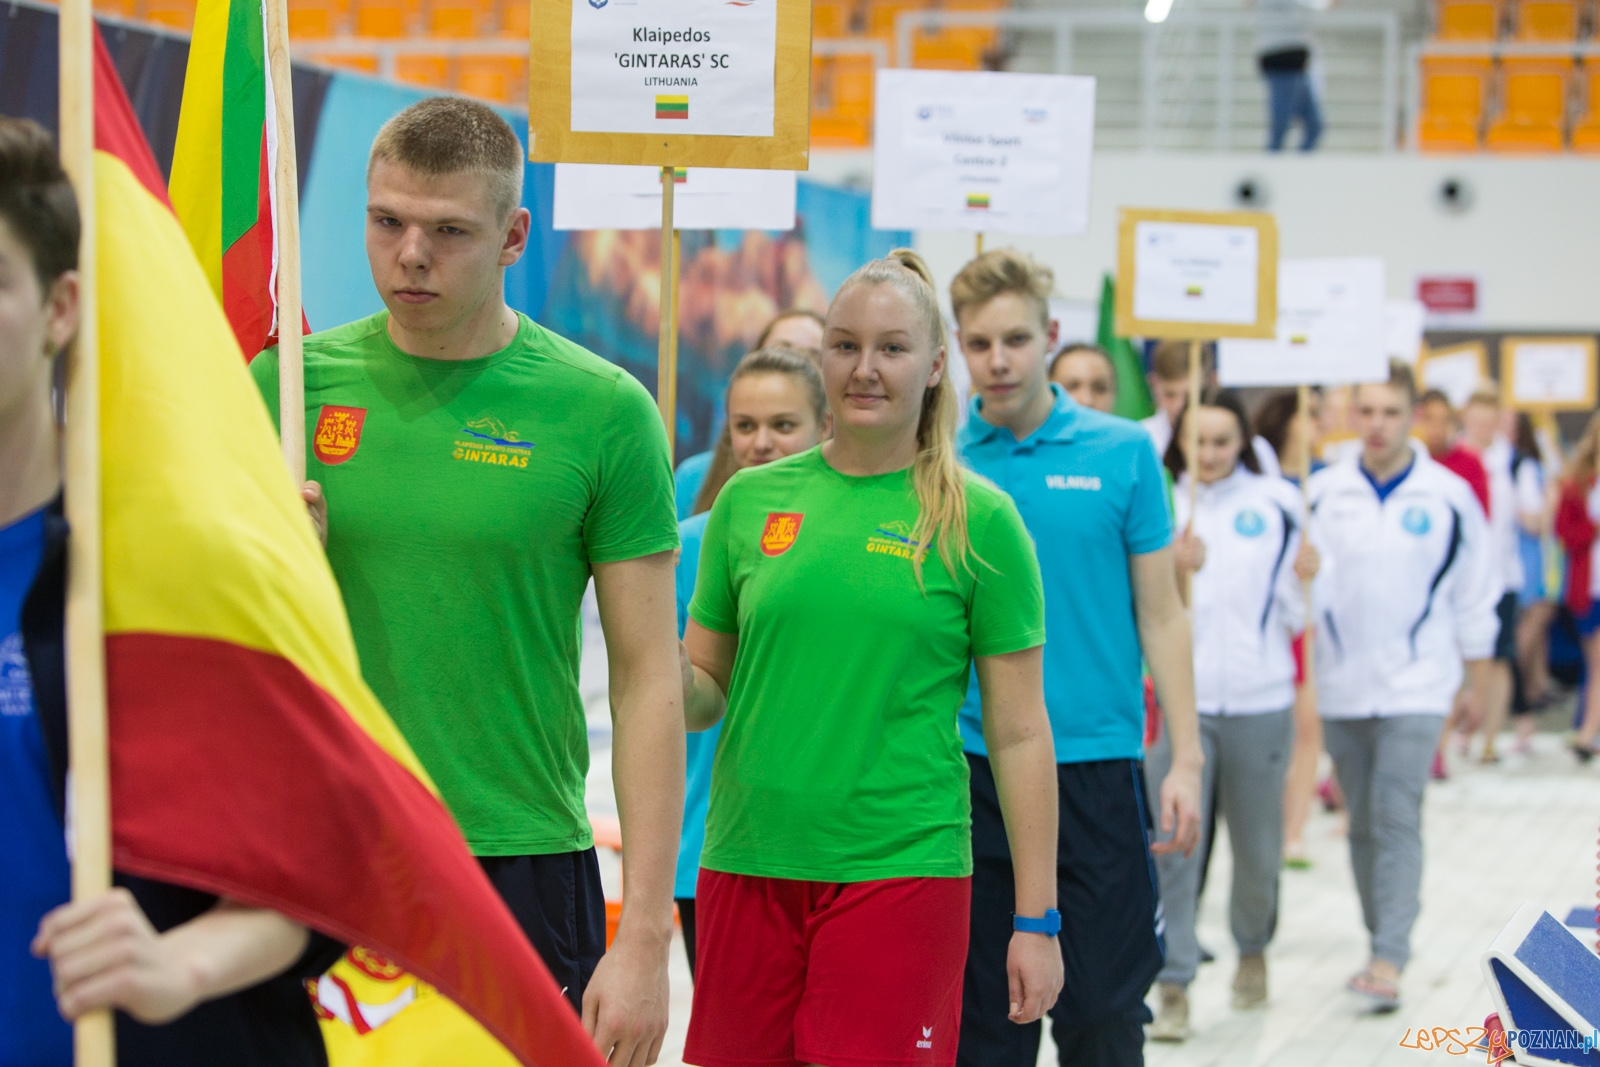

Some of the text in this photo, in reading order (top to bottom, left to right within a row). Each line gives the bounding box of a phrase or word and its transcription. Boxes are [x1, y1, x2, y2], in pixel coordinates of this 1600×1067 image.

[633, 27, 711, 45] Klaipedos
[614, 53, 729, 69] 'GINTARAS' SC
[644, 77, 698, 87] LITHUANIA
[452, 448, 529, 468] GINTARAS
[1045, 474, 1102, 491] VILNIUS
[866, 542, 928, 563] GINTARS
